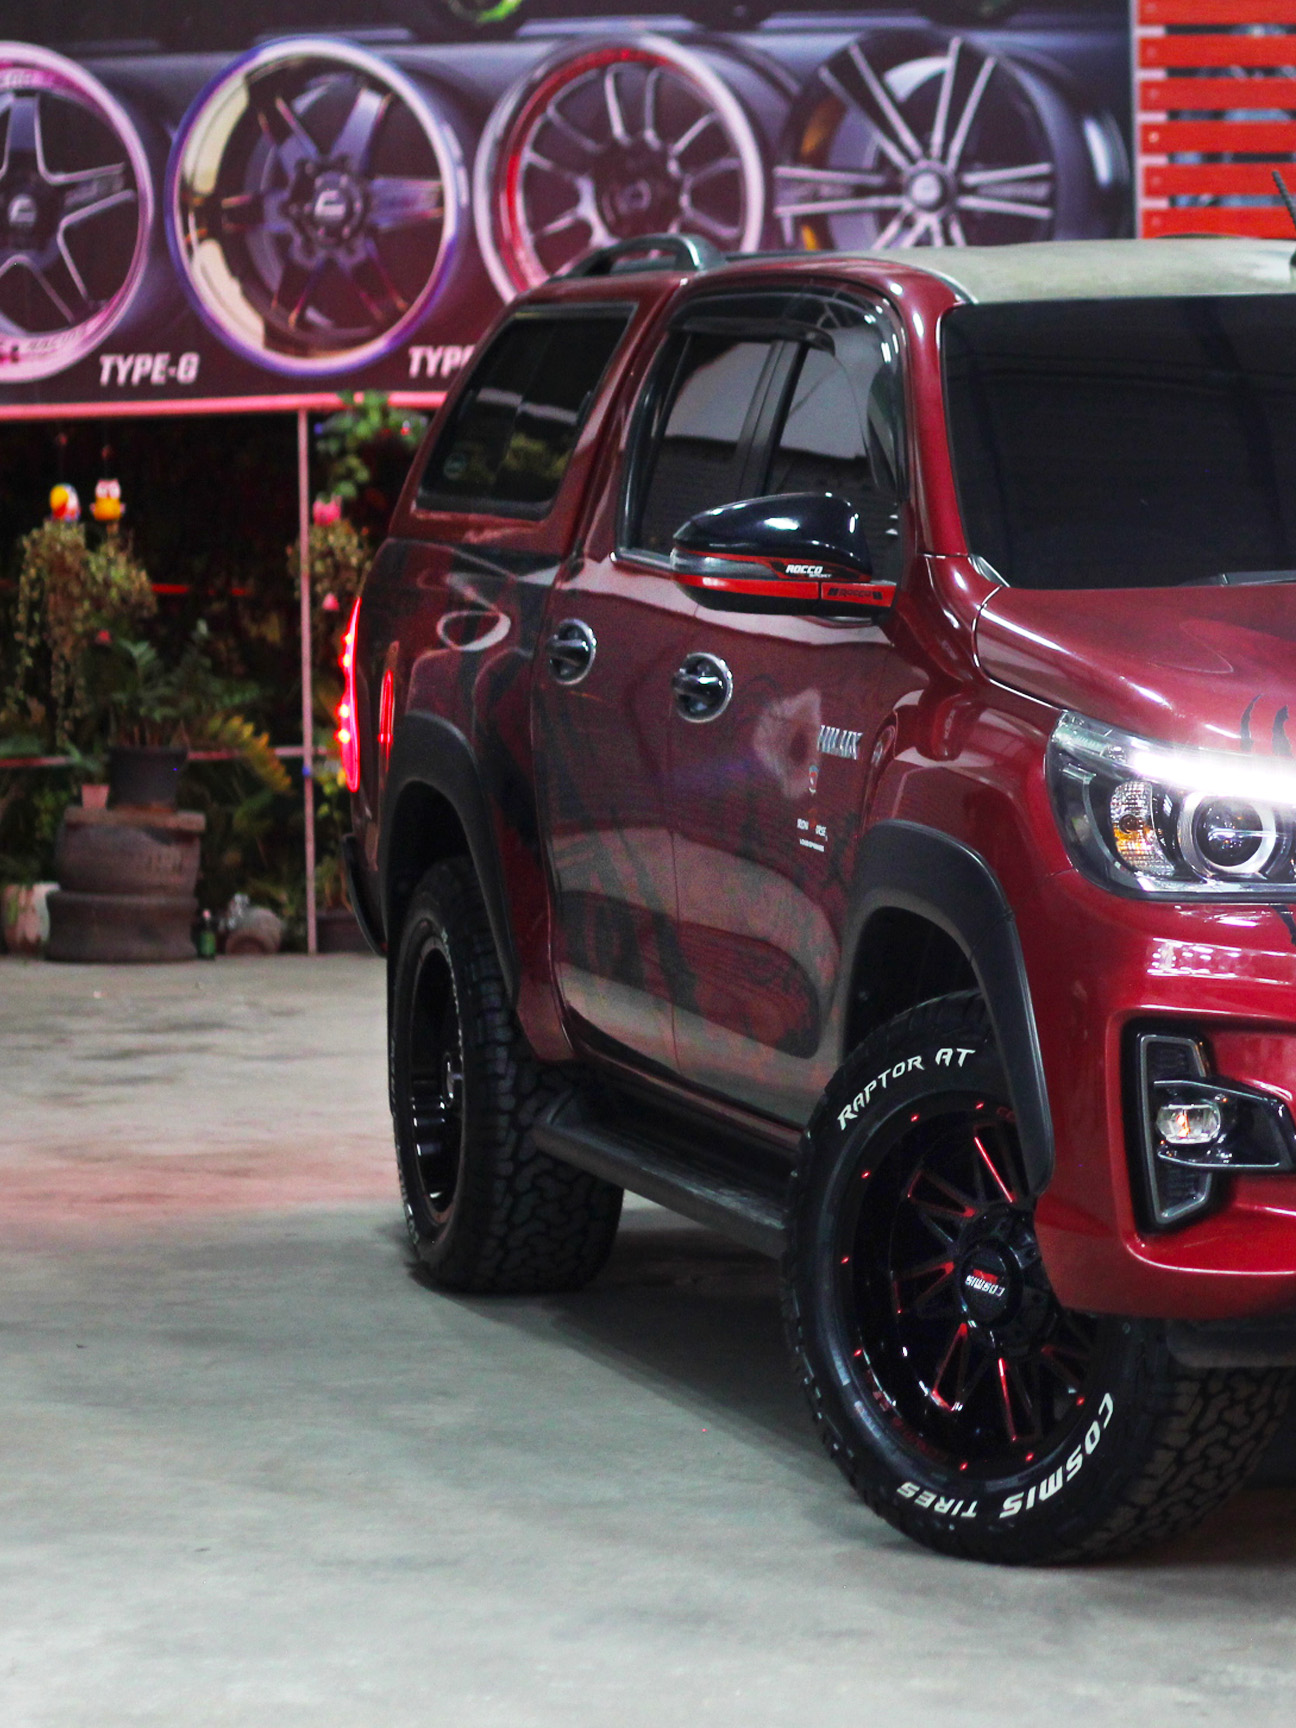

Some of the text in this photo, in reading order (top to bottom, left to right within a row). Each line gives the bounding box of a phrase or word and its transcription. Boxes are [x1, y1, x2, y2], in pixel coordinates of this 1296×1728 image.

[785, 564, 824, 575] ROCCO
[817, 725, 863, 760] HILUX
[837, 1048, 976, 1131] RAPTOR AT
[999, 1392, 1114, 1519] COSMIS
[896, 1481, 978, 1518] TIRES
